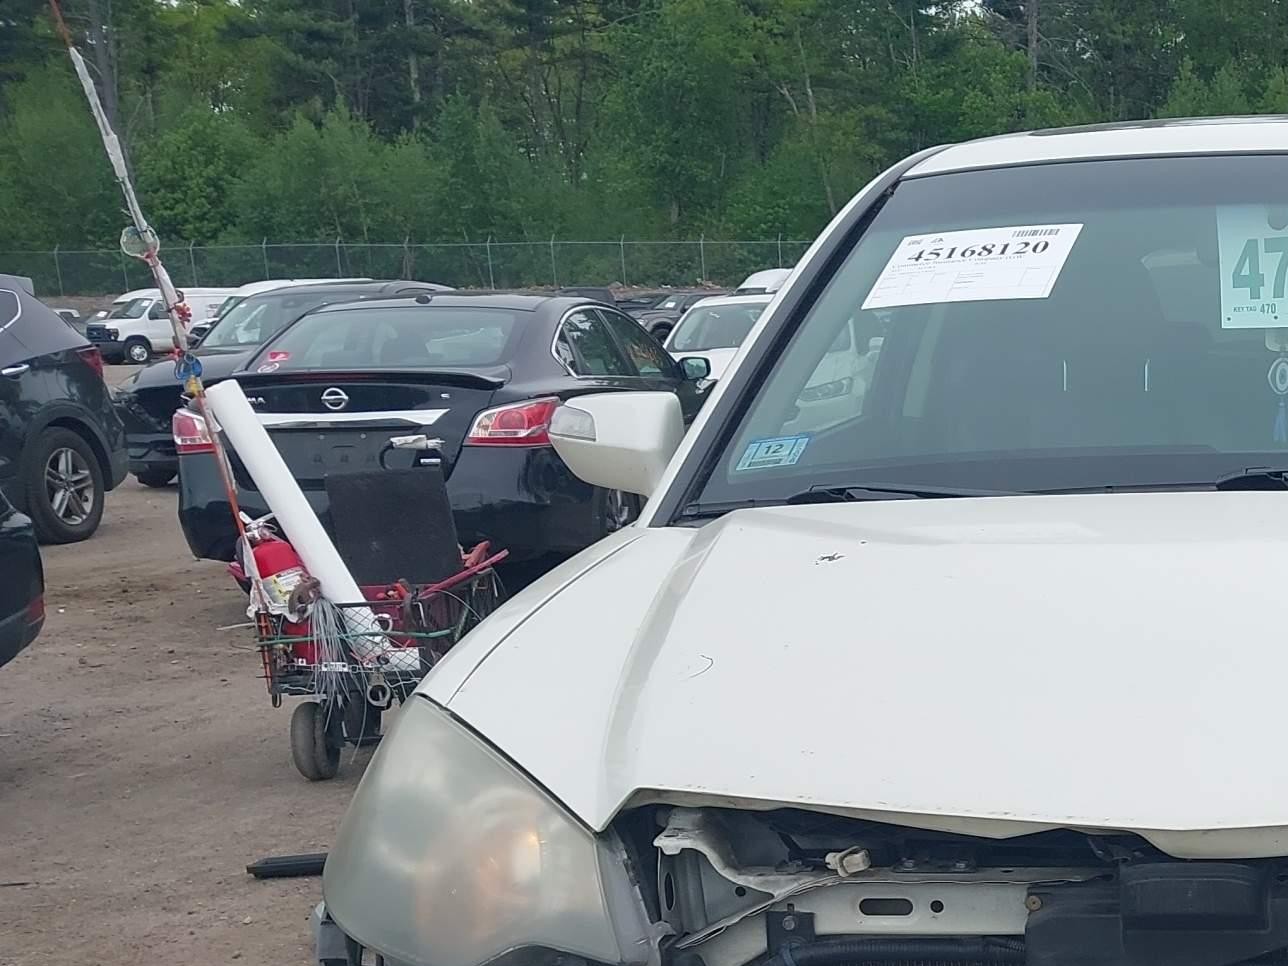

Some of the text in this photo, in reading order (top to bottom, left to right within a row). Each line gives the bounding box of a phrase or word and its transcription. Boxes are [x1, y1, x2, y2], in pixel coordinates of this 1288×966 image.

[907, 240, 1049, 262] 45168120
[1260, 303, 1276, 314] 470
[764, 443, 784, 455] 12
